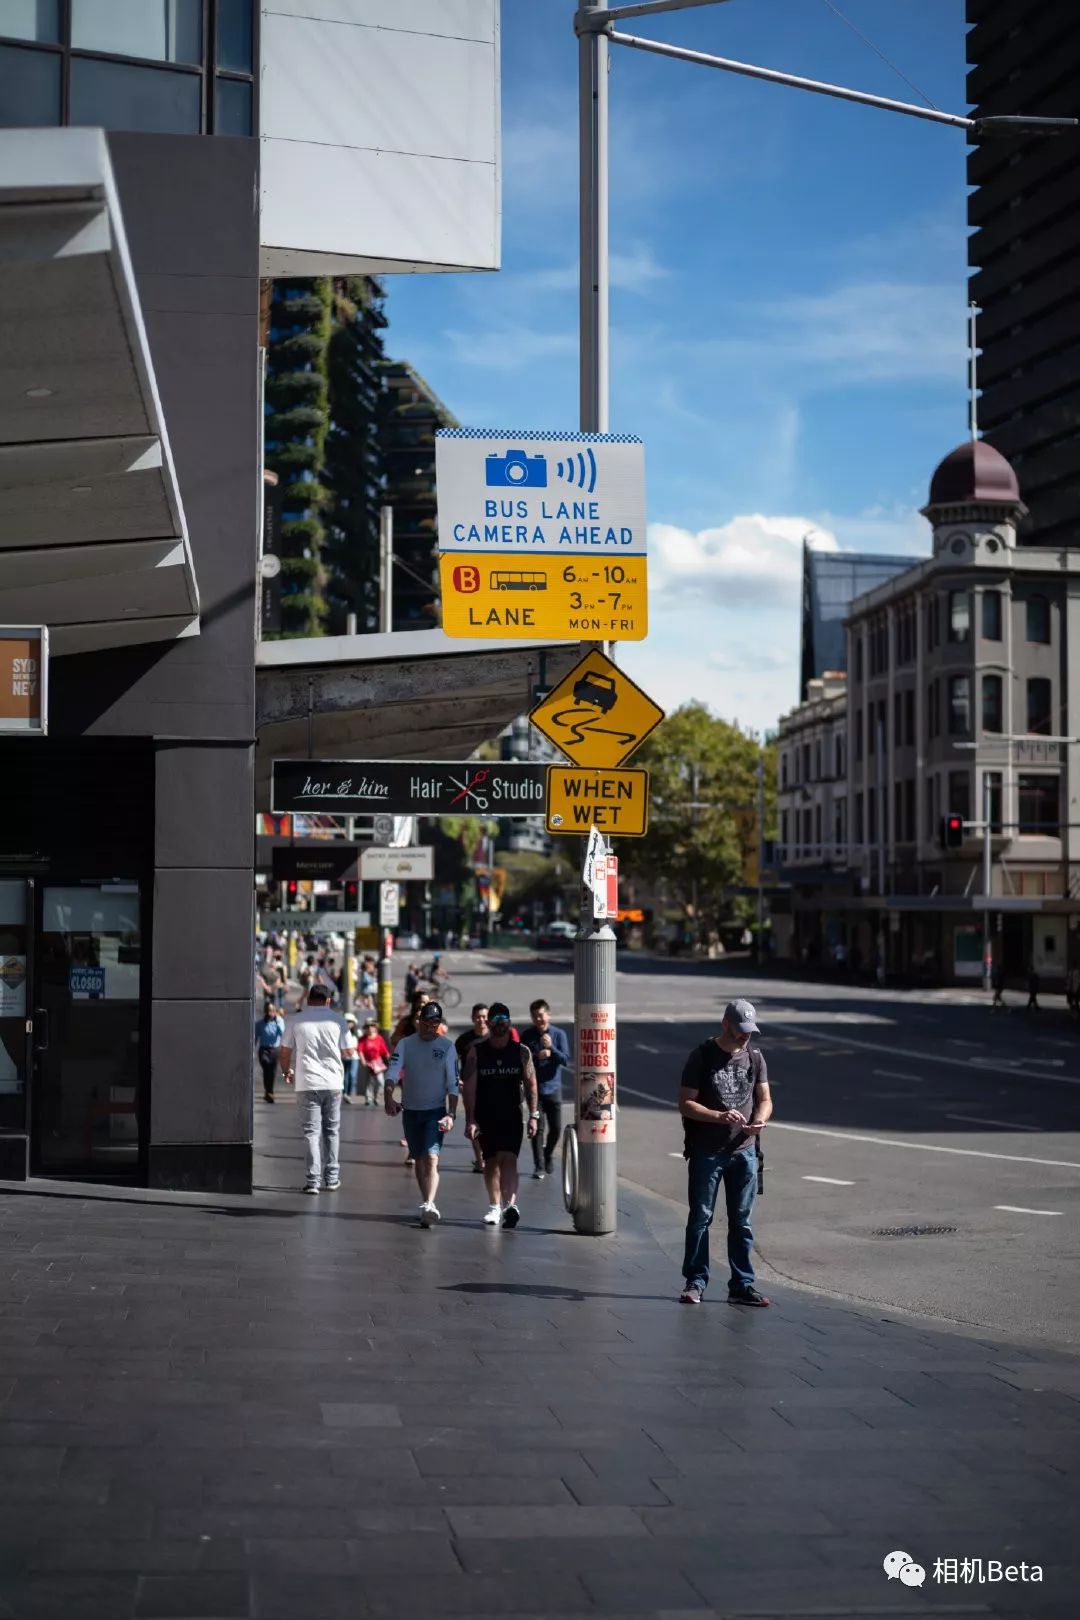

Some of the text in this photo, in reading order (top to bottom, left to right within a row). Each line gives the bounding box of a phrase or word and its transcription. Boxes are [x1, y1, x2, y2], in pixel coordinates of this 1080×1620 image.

[485, 500, 600, 520] BUS LANE
[453, 524, 633, 545] CAMERA AHEAD
[460, 566, 477, 592] B
[469, 607, 535, 626] LANE
[301, 776, 390, 796] her & him
[410, 776, 543, 800] Hair Studio
[563, 778, 633, 800] WHEN
[573, 804, 622, 825] WET
[70, 975, 102, 991] CLOSED
[580, 1028, 616, 1041] DATING
[580, 1041, 609, 1054] WITH
